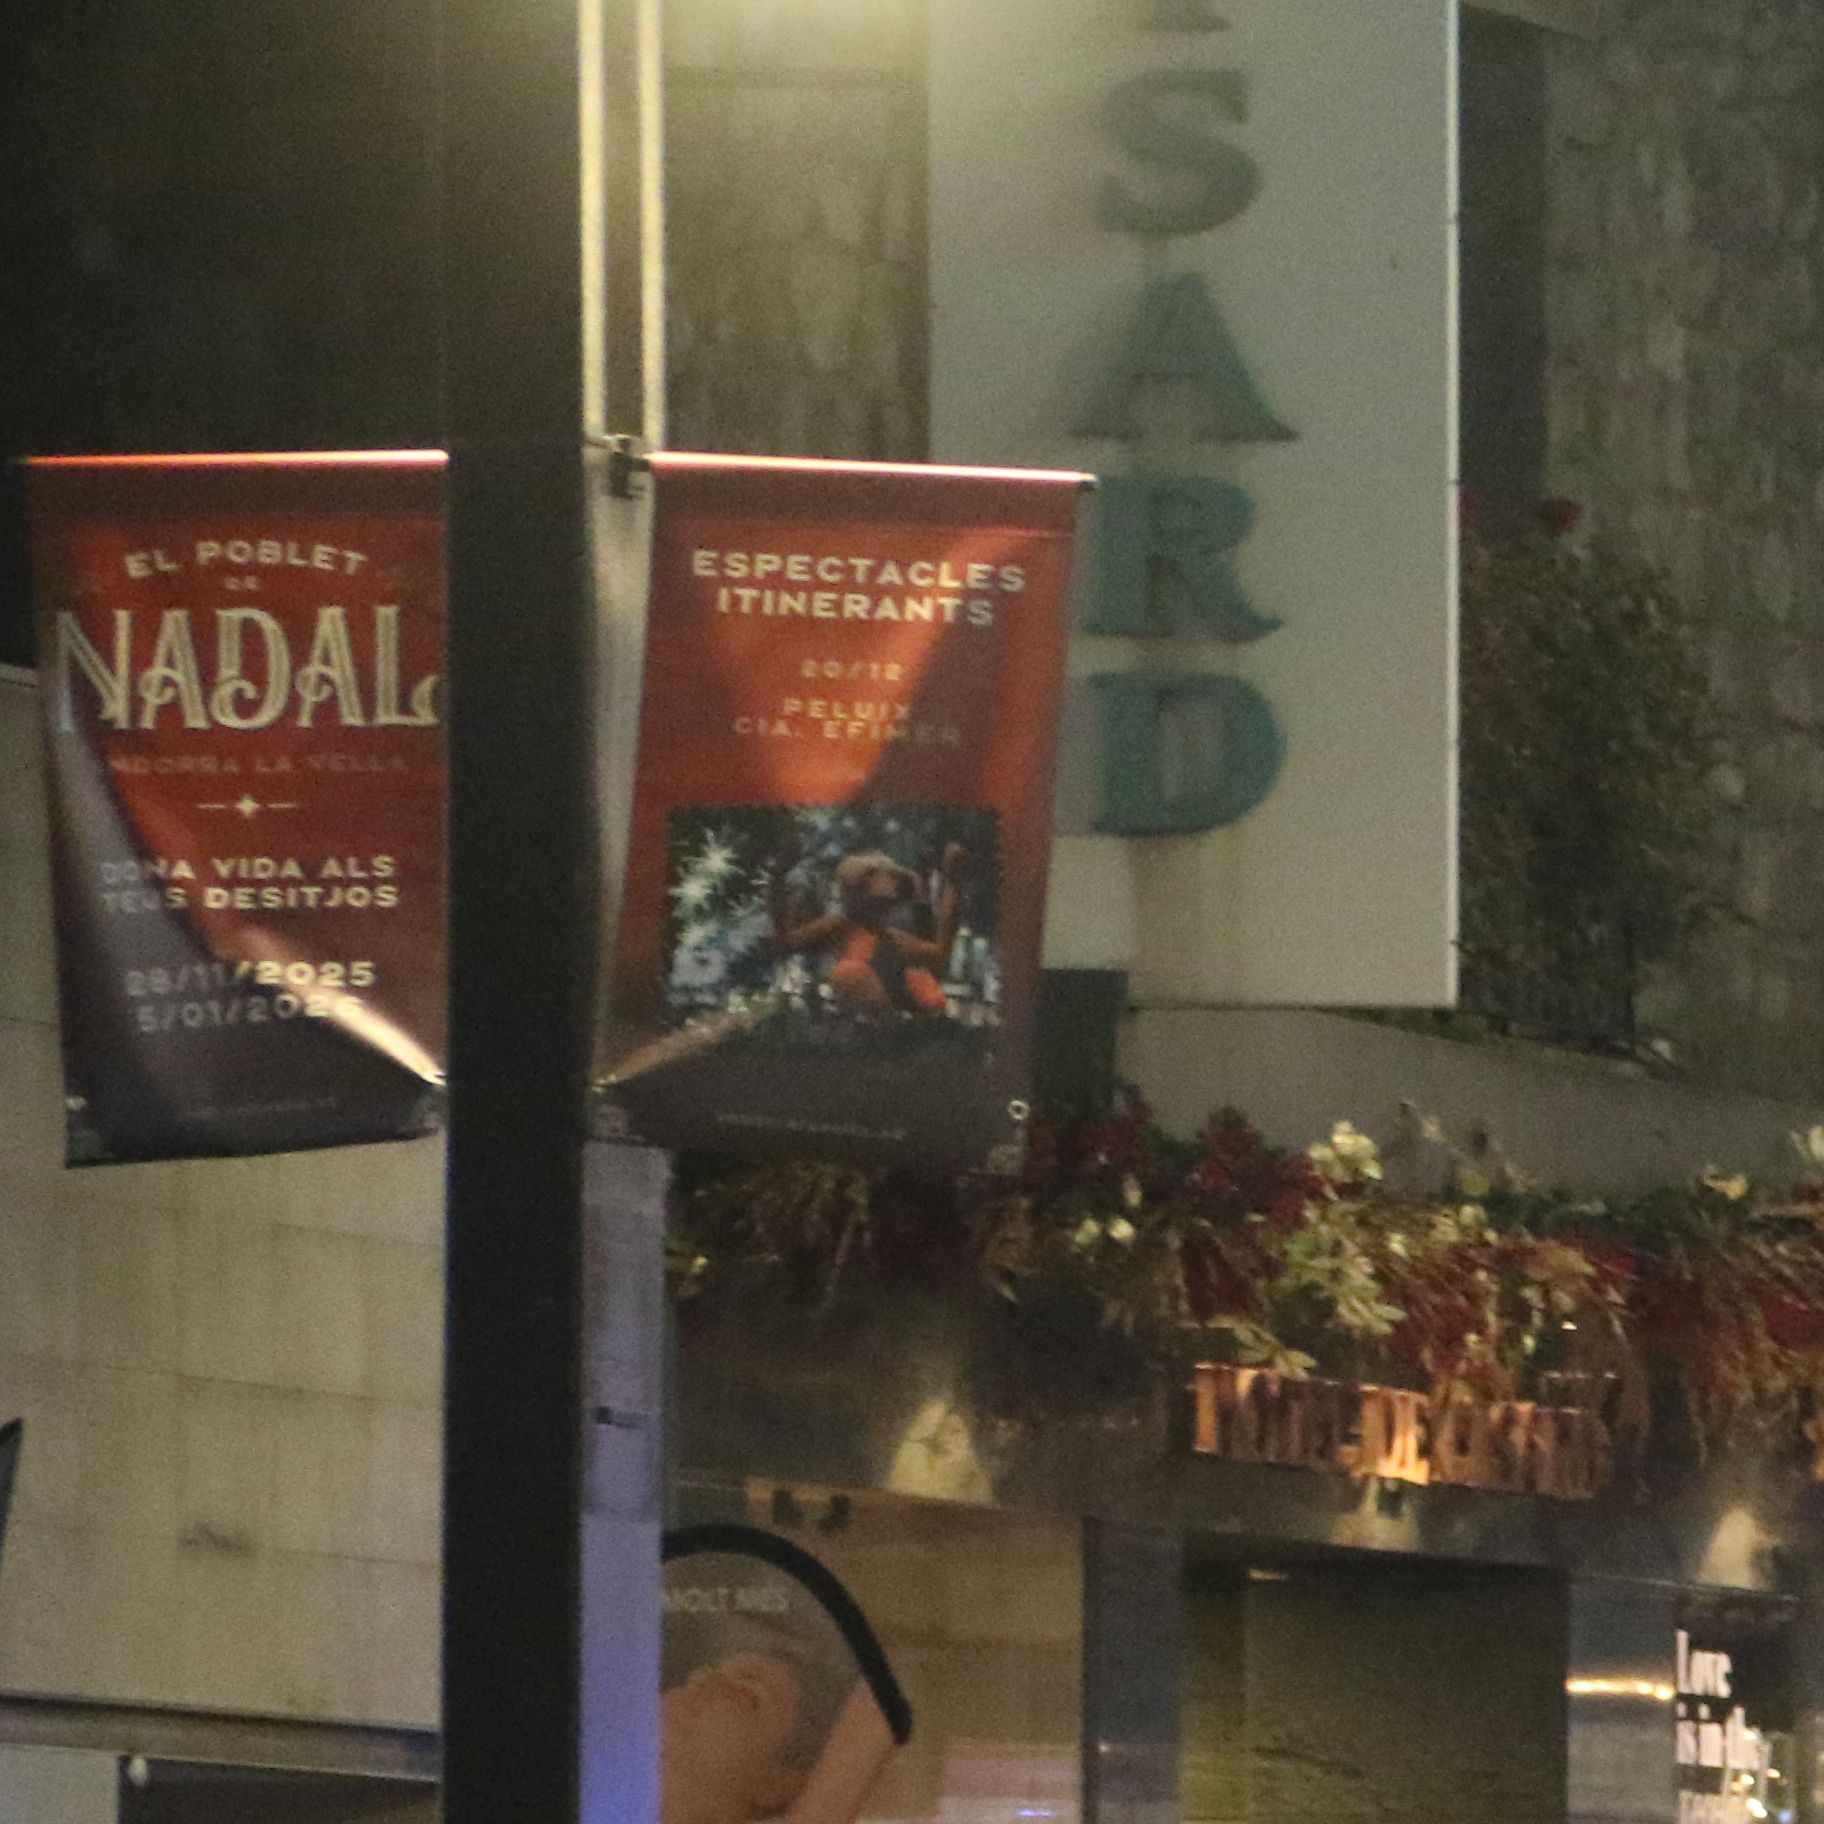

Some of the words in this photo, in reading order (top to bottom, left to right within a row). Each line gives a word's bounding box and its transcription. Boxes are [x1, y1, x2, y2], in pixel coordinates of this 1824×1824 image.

[1068, 0, 1300, 836] SARD
[124, 548, 180, 579] EL
[195, 539, 369, 575] POBLET
[692, 549, 1027, 593] ESPECTACLES
[718, 586, 996, 628] ITINERANTS
[55, 603, 441, 732] NADAL
[210, 856, 304, 882] VIDA
[320, 853, 398, 881] ALS
[203, 885, 400, 911] DESITJOS
